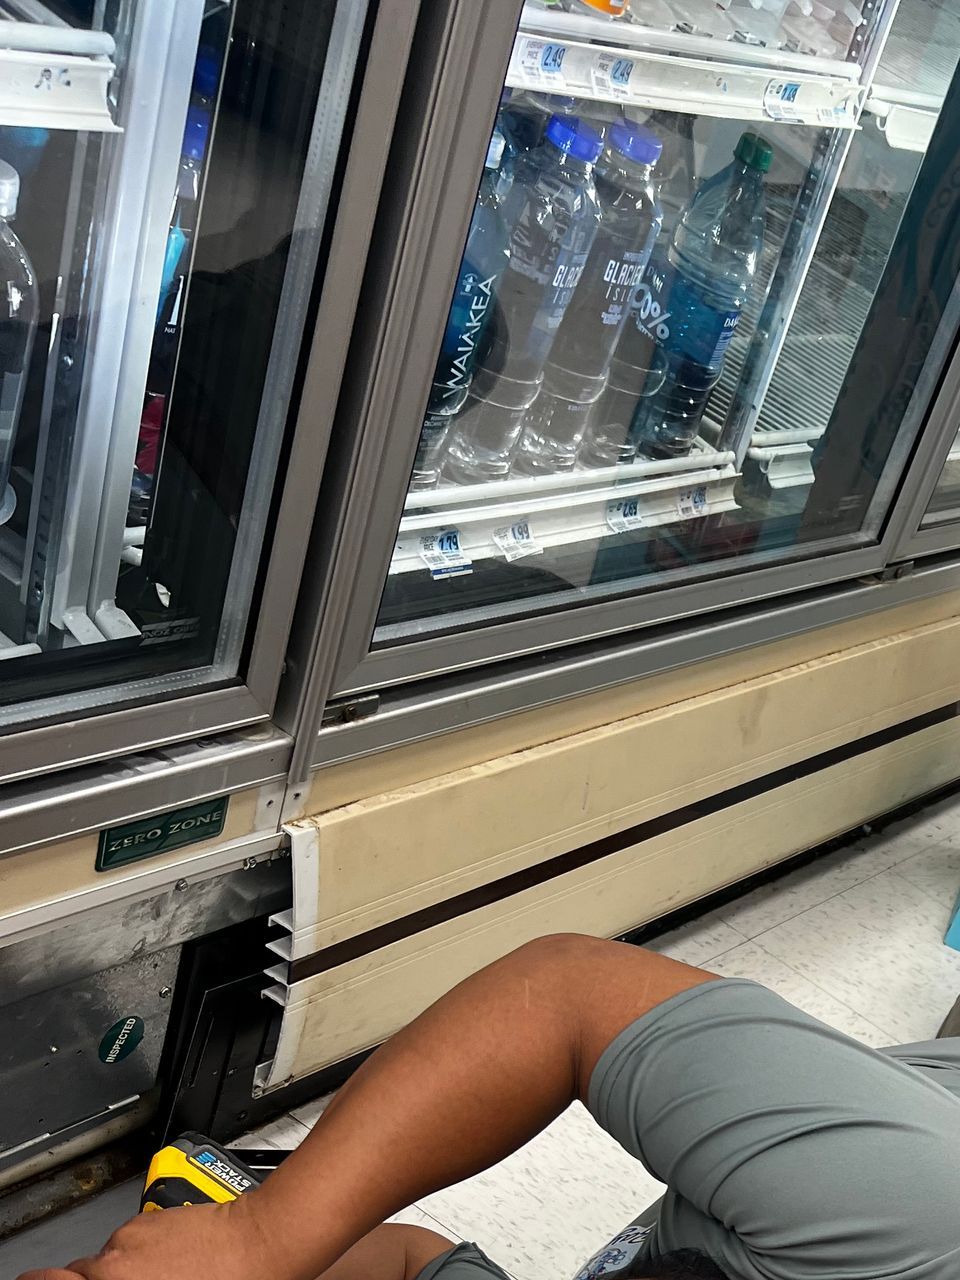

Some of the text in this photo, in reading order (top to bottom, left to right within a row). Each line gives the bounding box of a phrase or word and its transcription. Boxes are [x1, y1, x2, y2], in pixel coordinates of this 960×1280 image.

[543, 46, 566, 68] 2.49
[612, 60, 634, 83] 2.49
[109, 809, 223, 851] ZERO ZONE
[106, 1017, 137, 1063] INSPECTED
[204, 1161, 246, 1192] POWER
[214, 1160, 252, 1188] STACK
